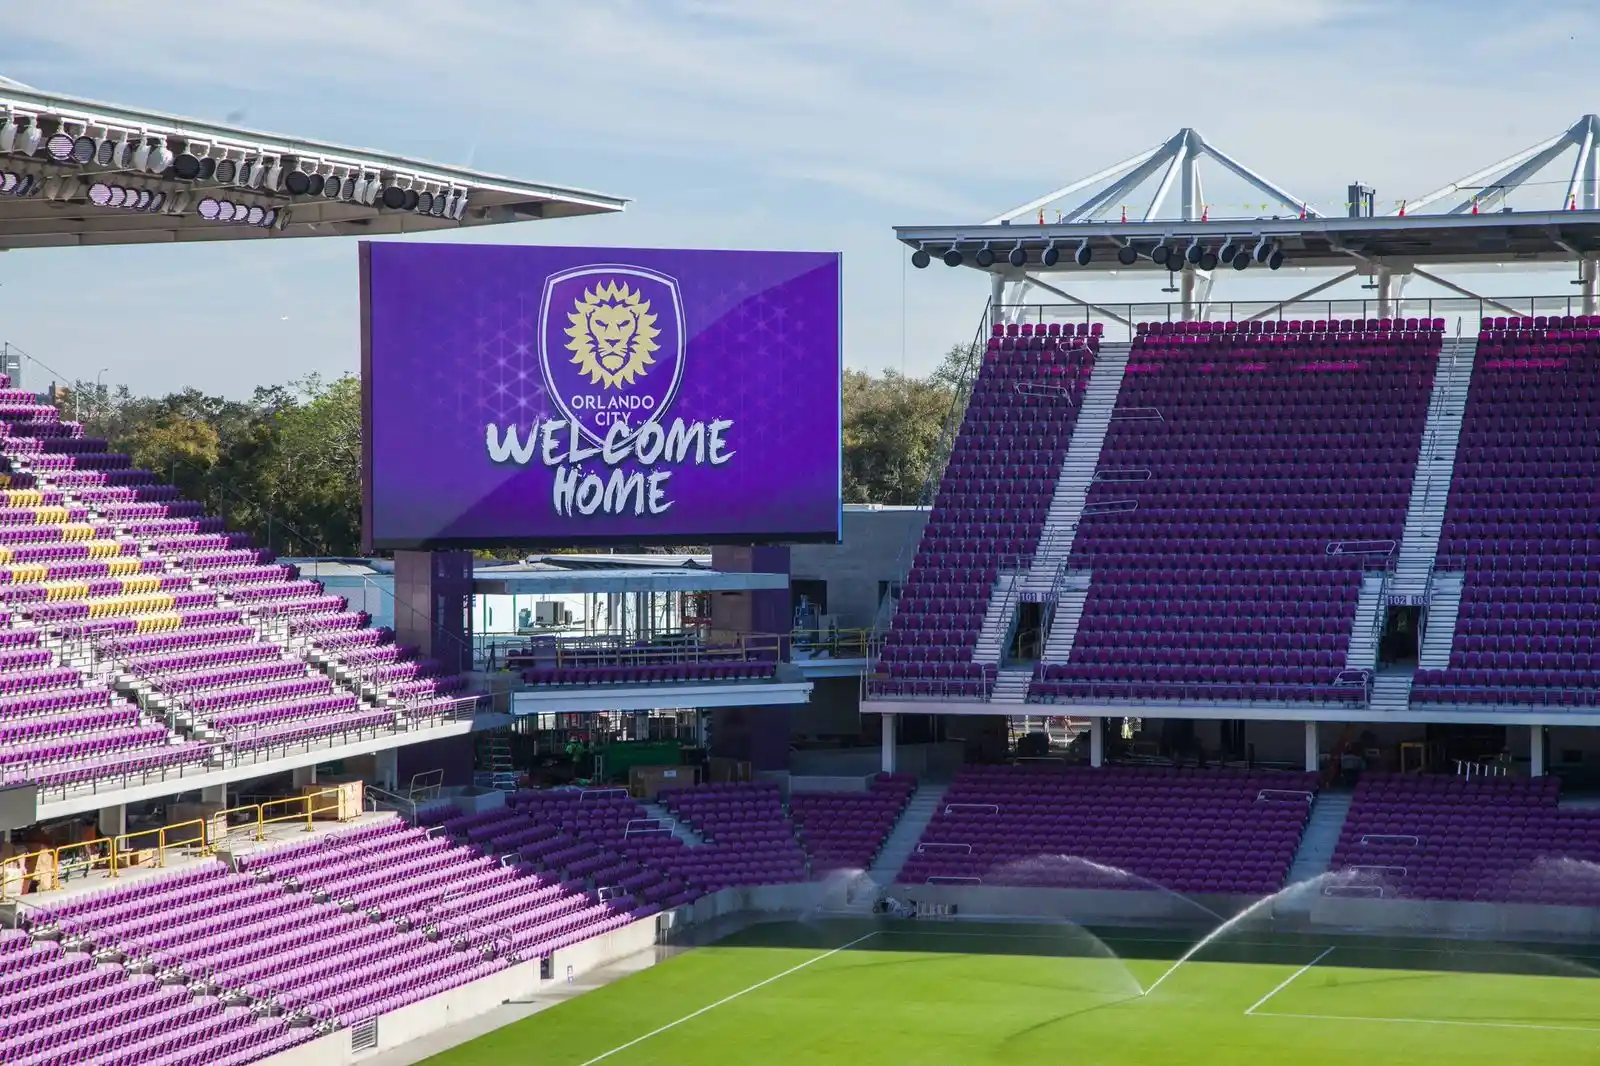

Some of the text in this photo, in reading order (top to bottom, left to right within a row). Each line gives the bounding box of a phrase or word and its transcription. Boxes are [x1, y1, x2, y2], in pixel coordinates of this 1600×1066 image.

[571, 395, 654, 409] ORLANDO
[595, 411, 631, 426] CITY
[486, 416, 736, 465] WELCOME
[553, 464, 675, 517] HOME
[1389, 596, 1406, 605] 102
